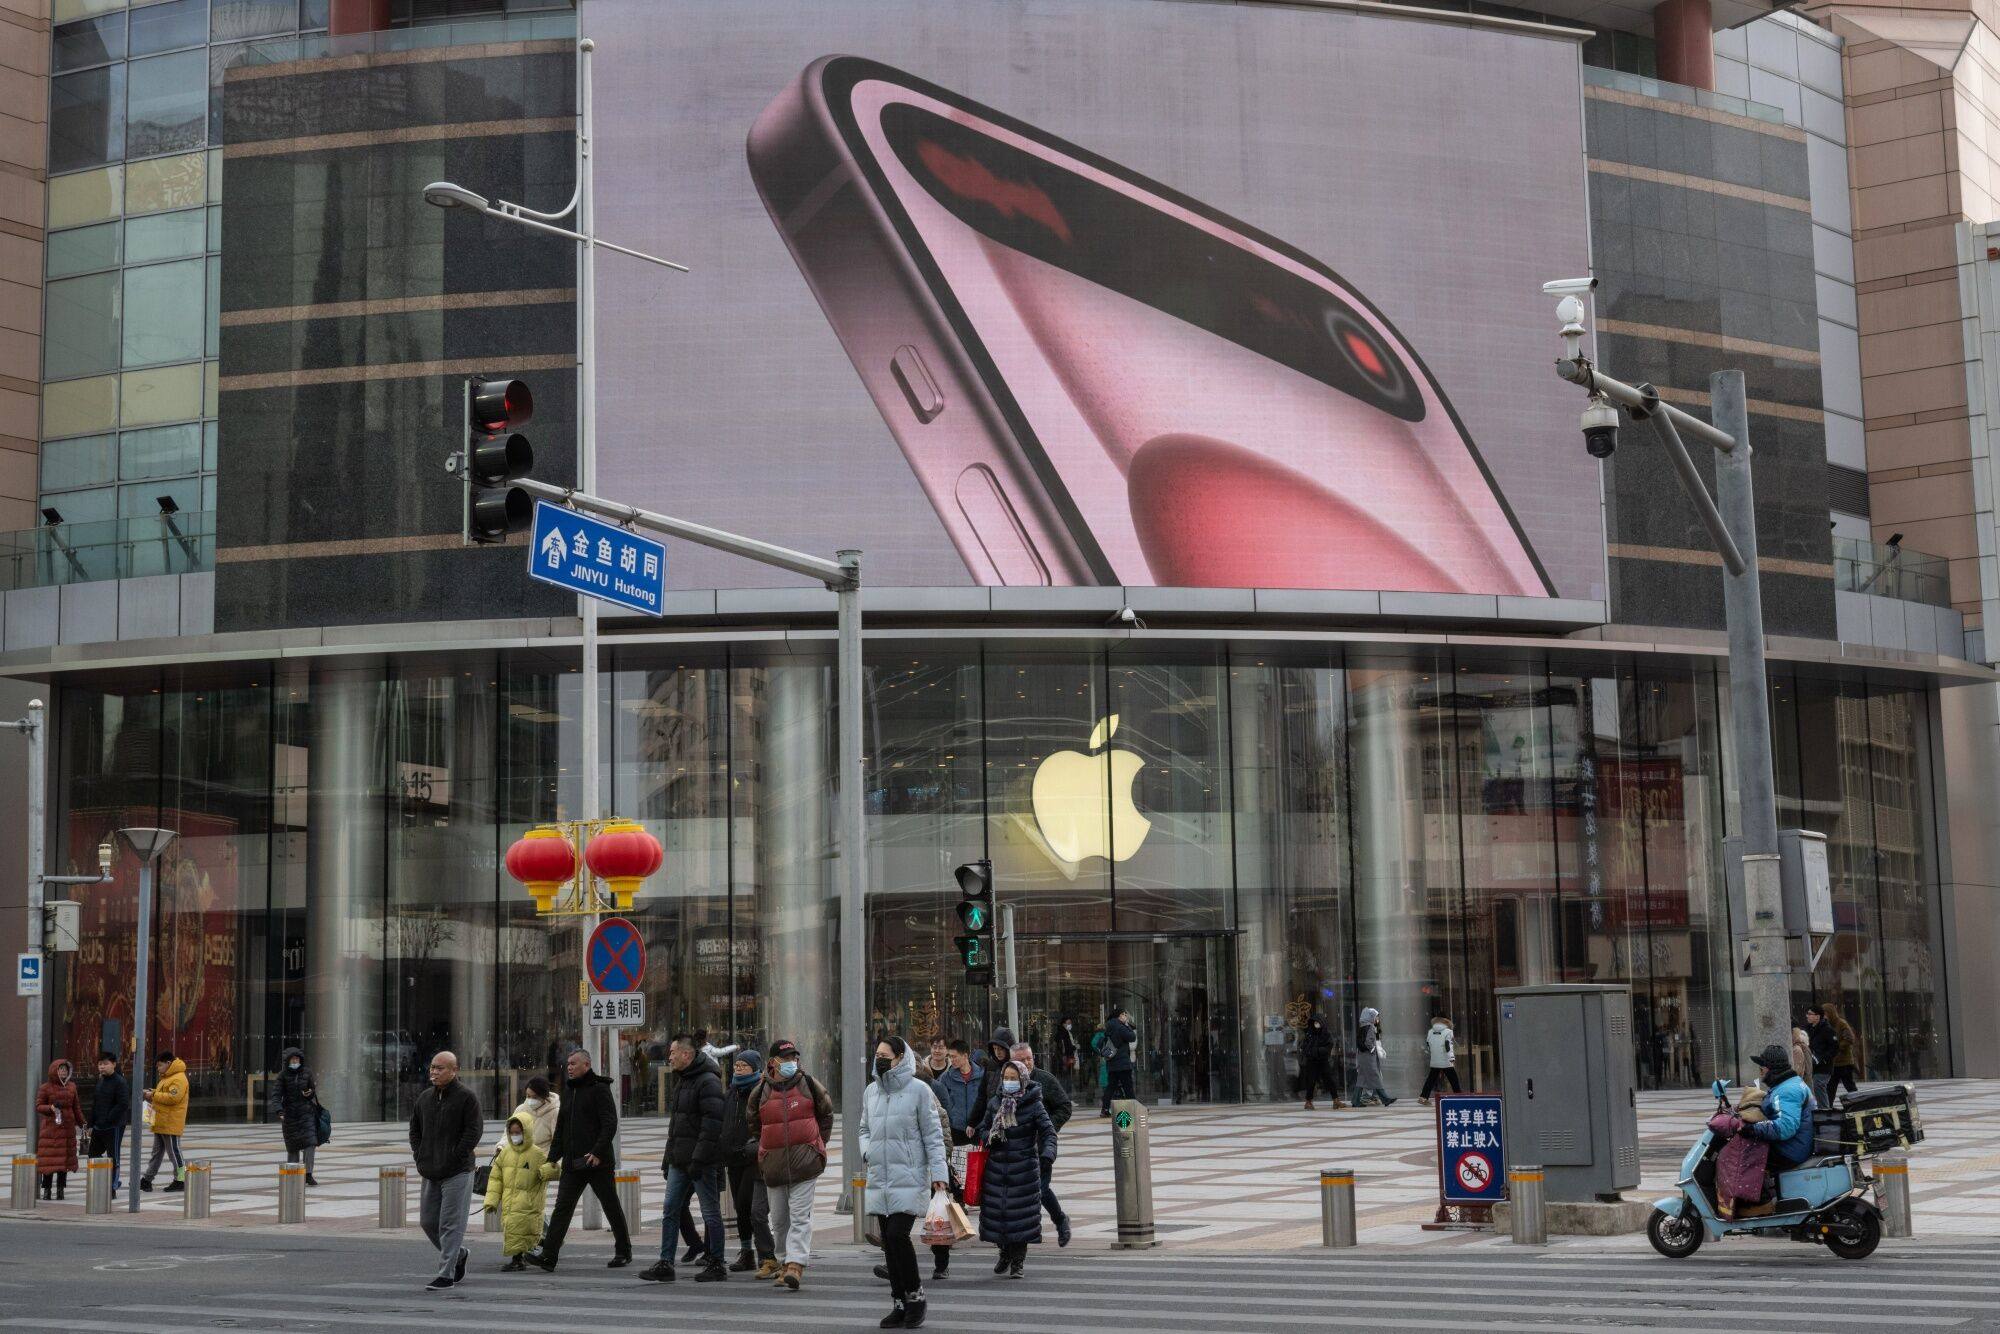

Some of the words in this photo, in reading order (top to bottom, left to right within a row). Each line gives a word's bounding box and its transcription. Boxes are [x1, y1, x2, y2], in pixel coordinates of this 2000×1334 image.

[550, 553, 558, 565] E
[572, 529, 658, 580] 金鱼胡同
[570, 564, 609, 587] JINYU
[614, 577, 656, 606] Hutong
[592, 998, 641, 1020] 金鱼胡同
[1445, 1109, 1498, 1127] 共享单车
[1446, 1131, 1500, 1148] 禁止驶入
